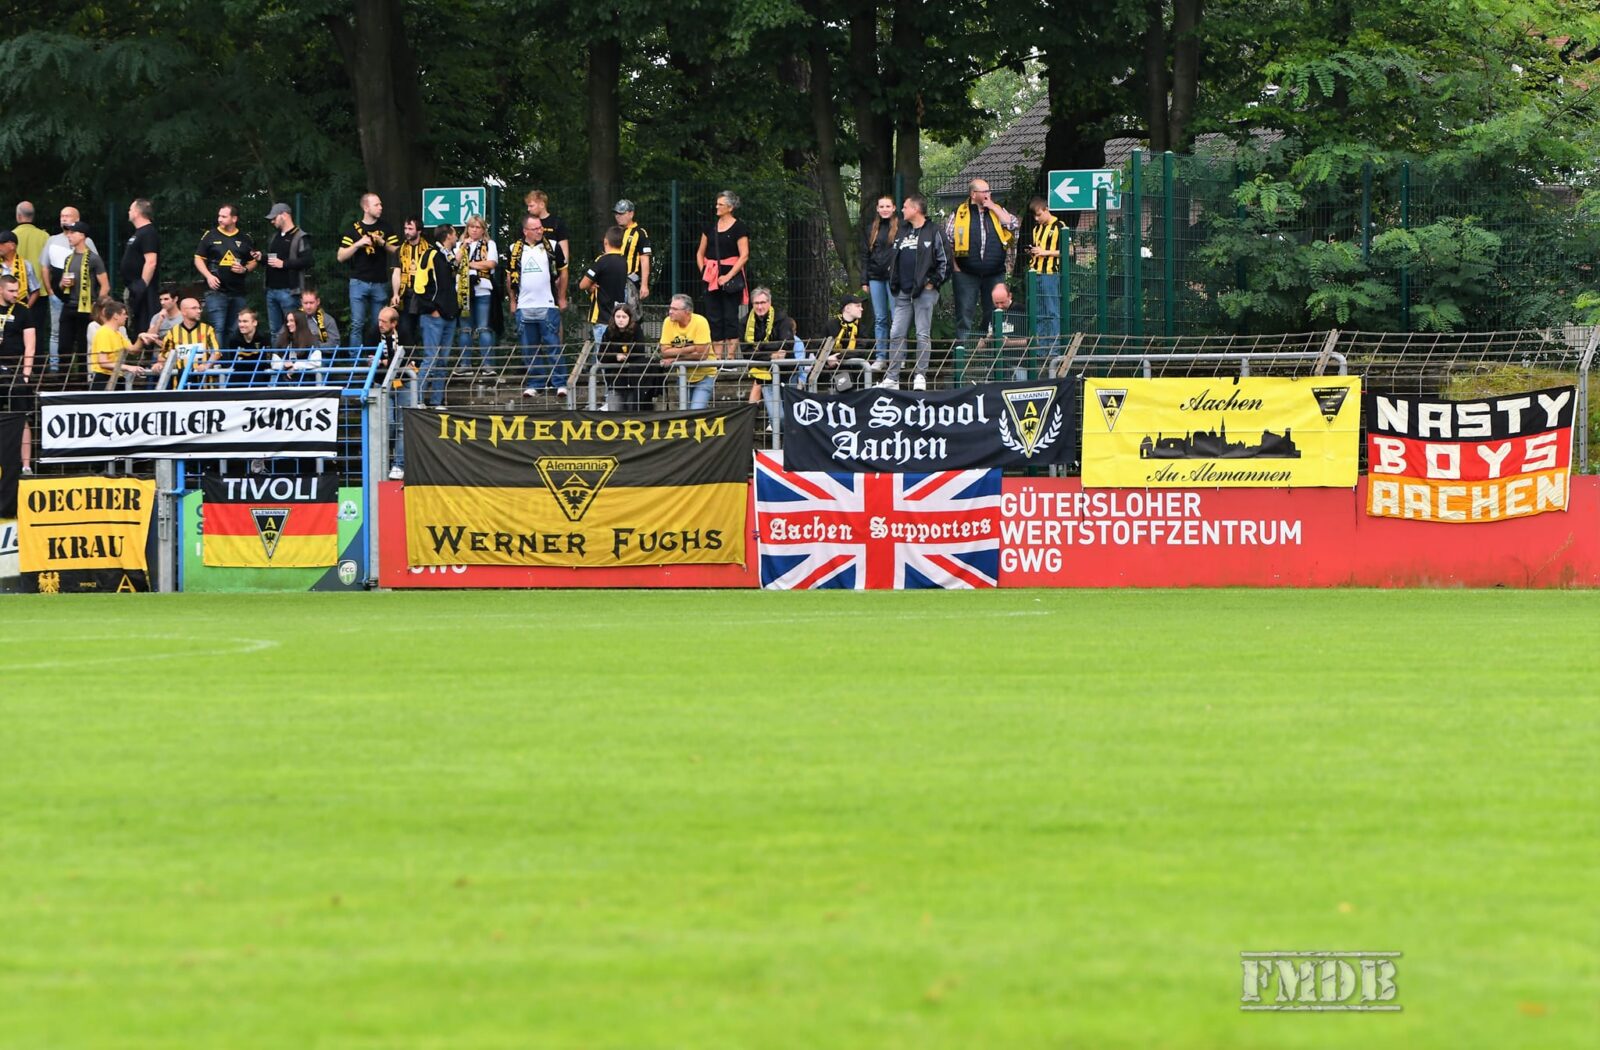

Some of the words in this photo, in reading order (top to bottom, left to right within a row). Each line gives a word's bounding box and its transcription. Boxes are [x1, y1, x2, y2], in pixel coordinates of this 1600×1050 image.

[1010, 391, 1050, 400] ALEMANNIA
[1180, 389, 1263, 411] Aachen
[792, 398, 856, 429] Old
[868, 393, 990, 430] School
[1024, 401, 1038, 417] A
[1376, 391, 1570, 438] NASTY
[831, 430, 948, 465] Aachen
[1373, 432, 1557, 479] BOYS
[546, 460, 609, 471] Alemannia
[1182, 463, 1291, 482] Alemannen
[28, 487, 141, 513] OECHER
[223, 477, 318, 500] TIVOLI
[1372, 472, 1565, 520] AACHEN
[1001, 487, 1201, 517] GÜTERSLOHER
[264, 516, 277, 530] A
[769, 516, 853, 542] Aachen
[869, 516, 991, 543] Supporters
[1000, 520, 1302, 545] WERTSTOFFZENTRUM
[48, 535, 125, 560] KRAU
[1001, 548, 1062, 572] GWG
